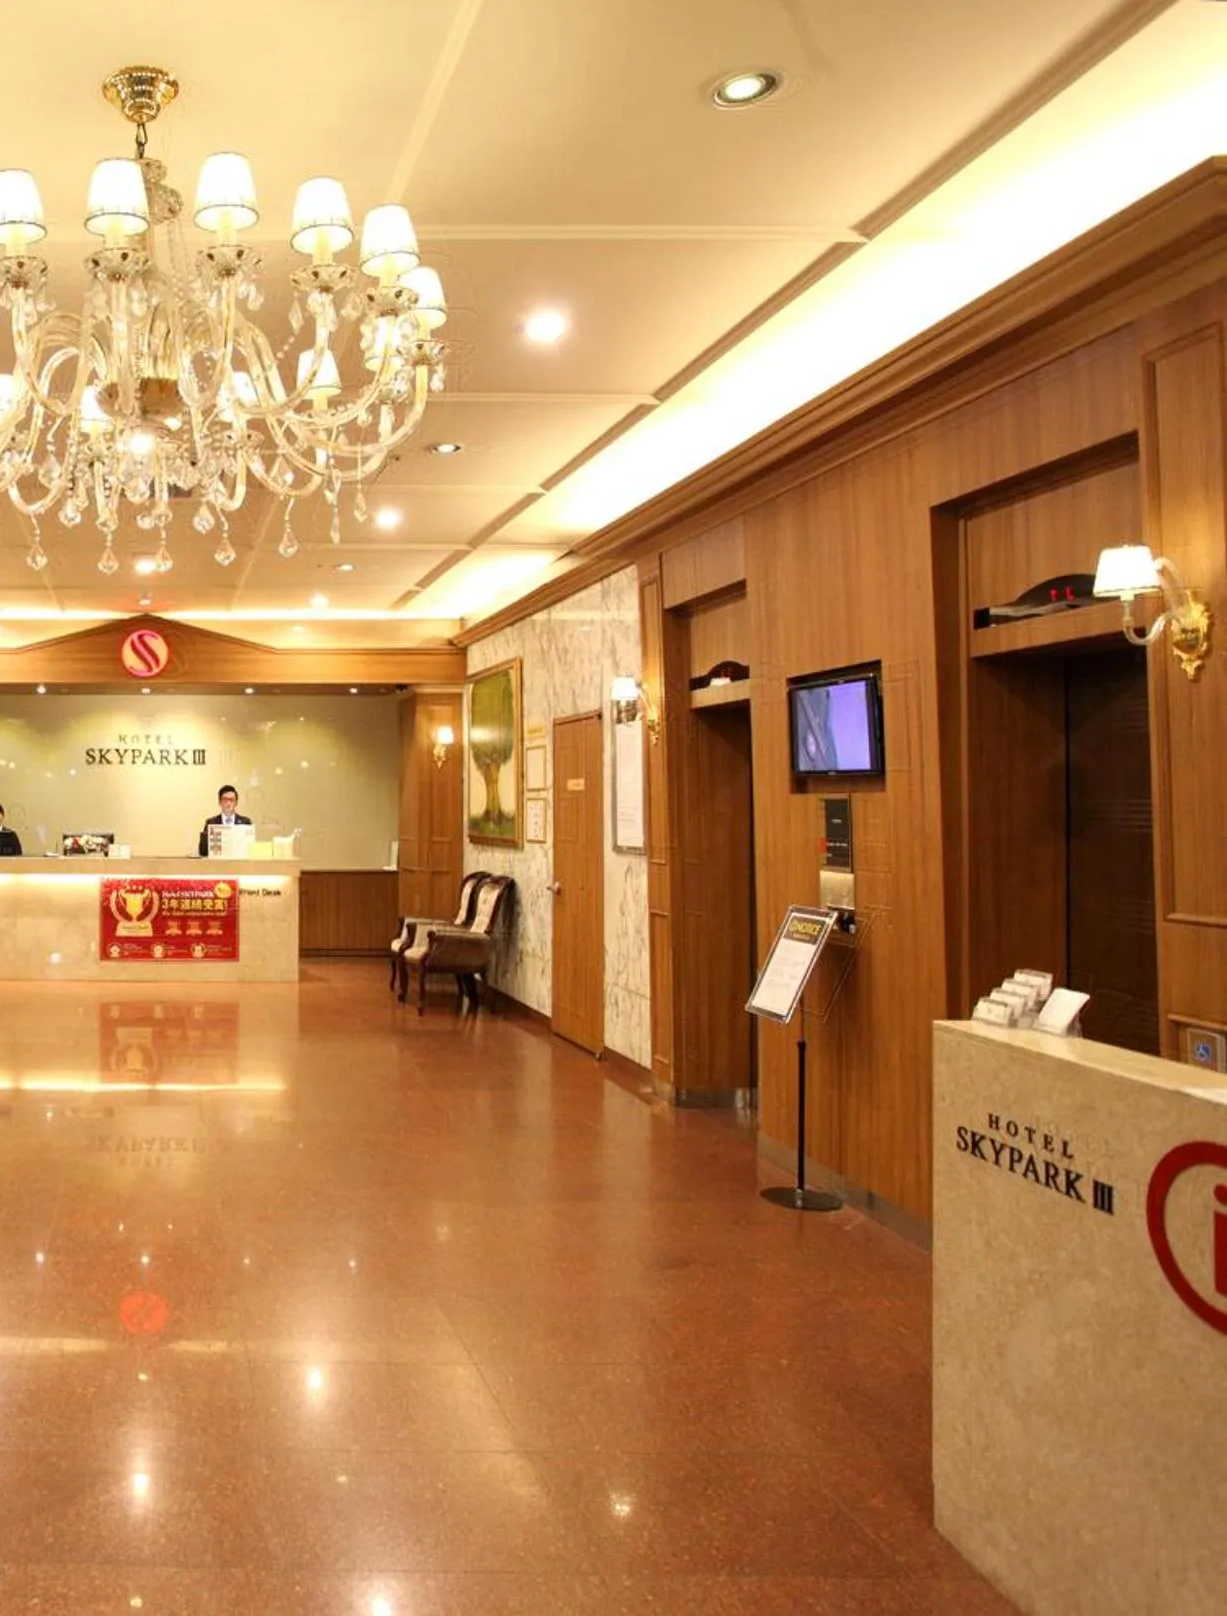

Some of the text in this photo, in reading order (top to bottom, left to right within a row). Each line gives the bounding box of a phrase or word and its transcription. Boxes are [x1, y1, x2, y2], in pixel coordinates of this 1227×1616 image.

[118, 734, 174, 745] HOTEL
[988, 1113, 1074, 1160] HOTEL
[956, 1126, 1087, 1205] SKYPARK
